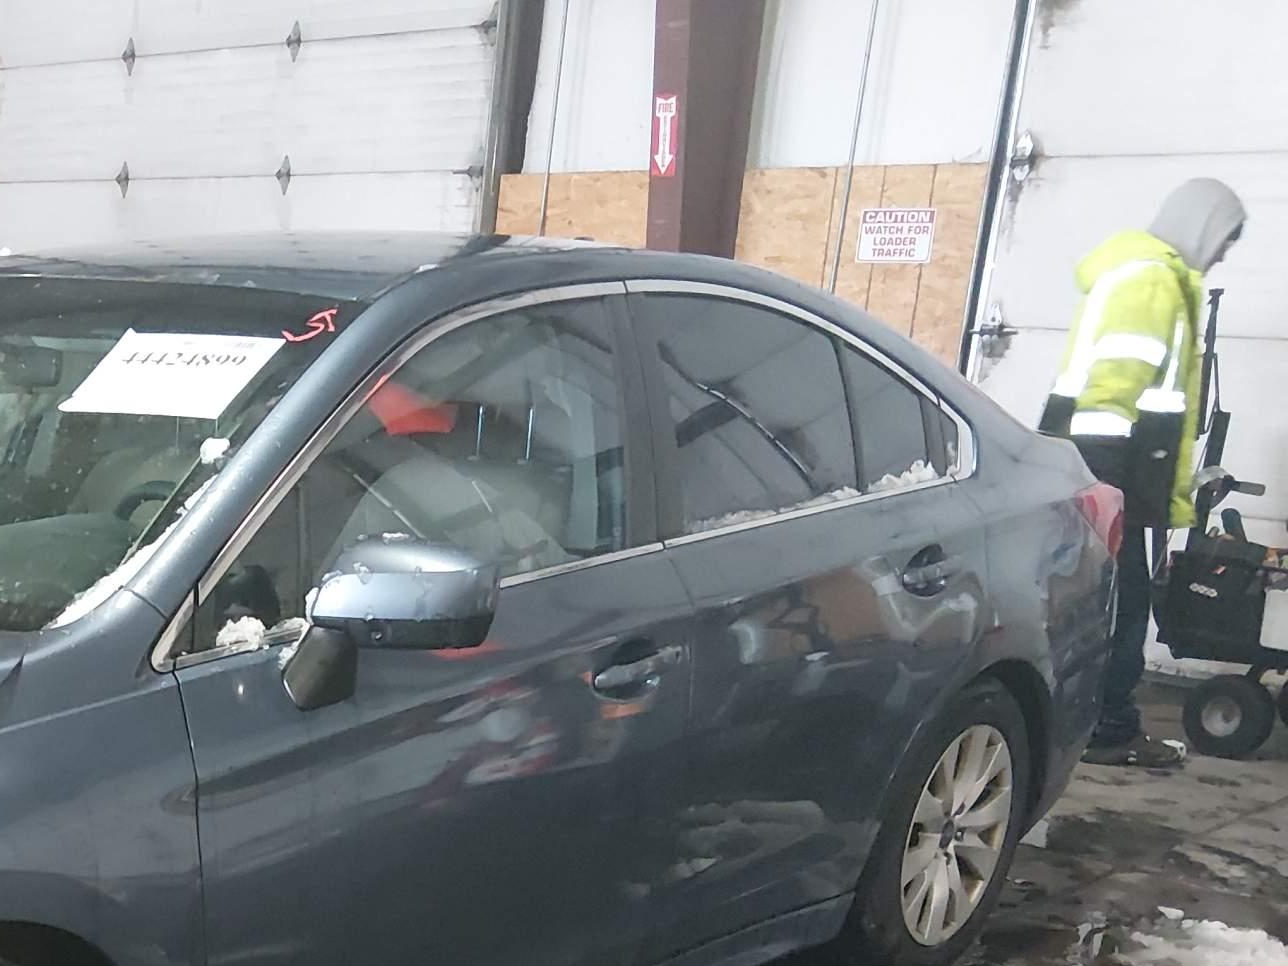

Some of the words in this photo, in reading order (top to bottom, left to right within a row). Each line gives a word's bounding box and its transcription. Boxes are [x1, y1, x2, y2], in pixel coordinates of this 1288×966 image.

[658, 102, 674, 113] FIRE
[865, 211, 931, 223] CAUTION
[864, 225, 904, 235] WATCH
[907, 225, 930, 235] FOR
[873, 236, 917, 246] LOADER
[872, 248, 916, 257] TRAFFIC
